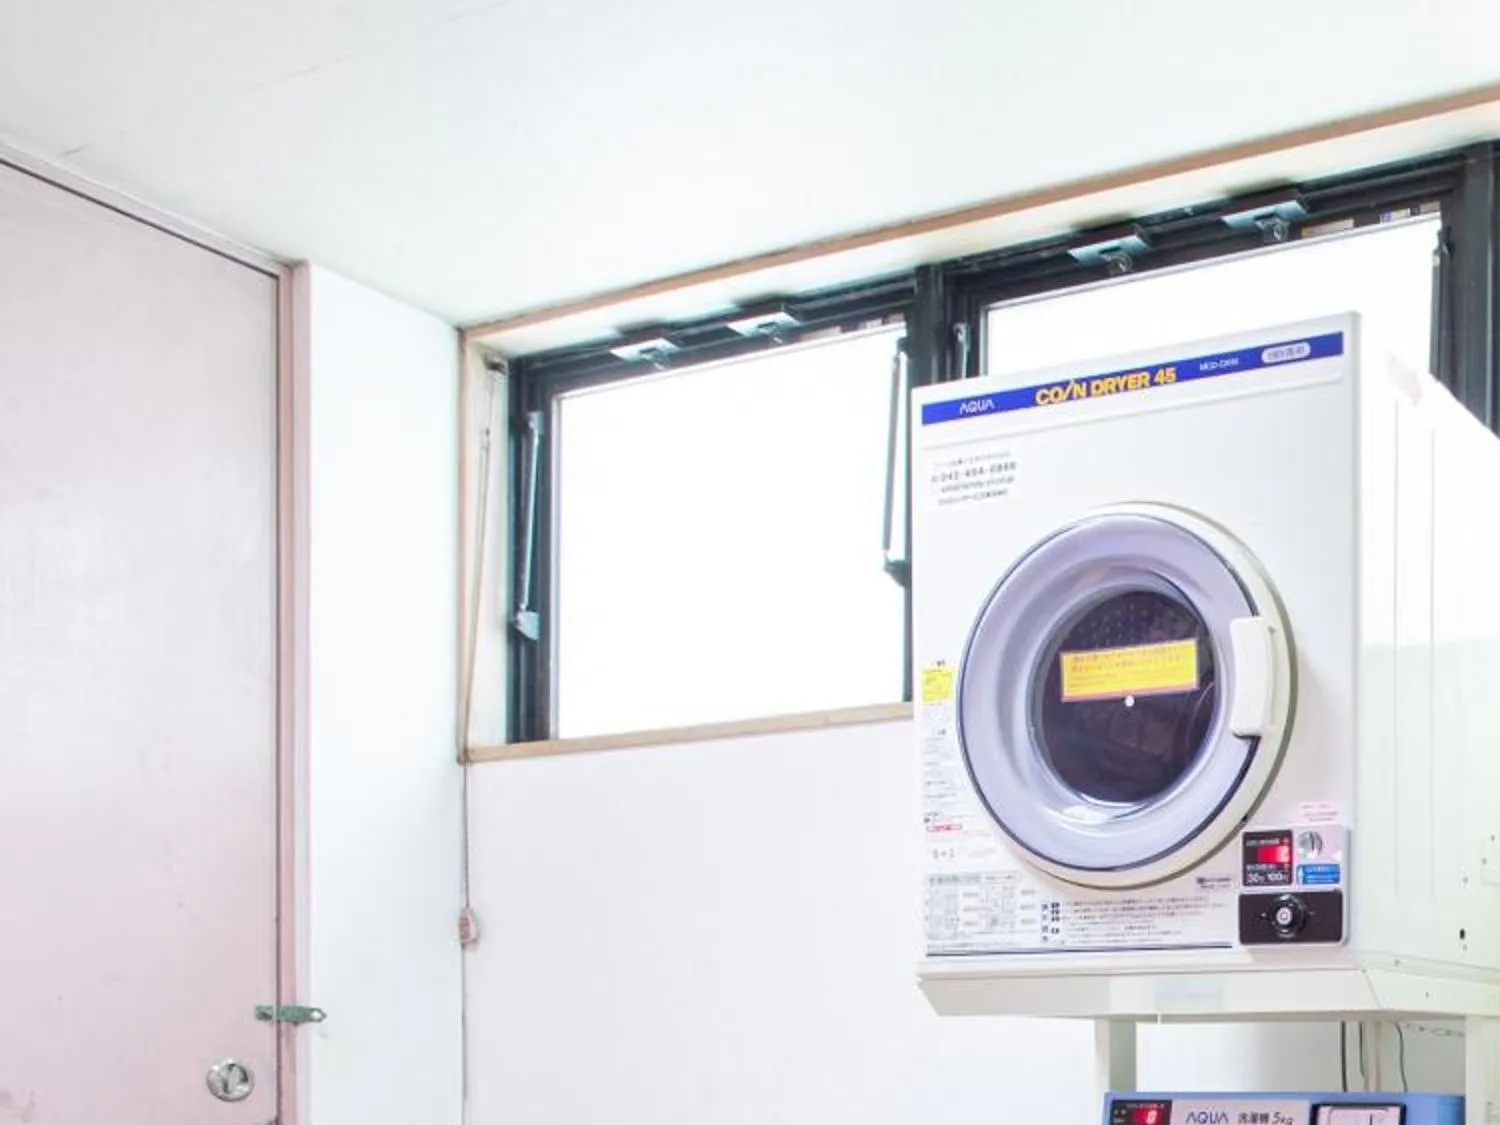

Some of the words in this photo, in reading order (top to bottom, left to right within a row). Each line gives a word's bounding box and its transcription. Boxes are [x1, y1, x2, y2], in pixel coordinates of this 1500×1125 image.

[1091, 373, 1150, 398] DRYER
[1153, 367, 1176, 386] 45
[960, 400, 995, 414] AQUA
[1186, 1111, 1229, 1125] AQUA
